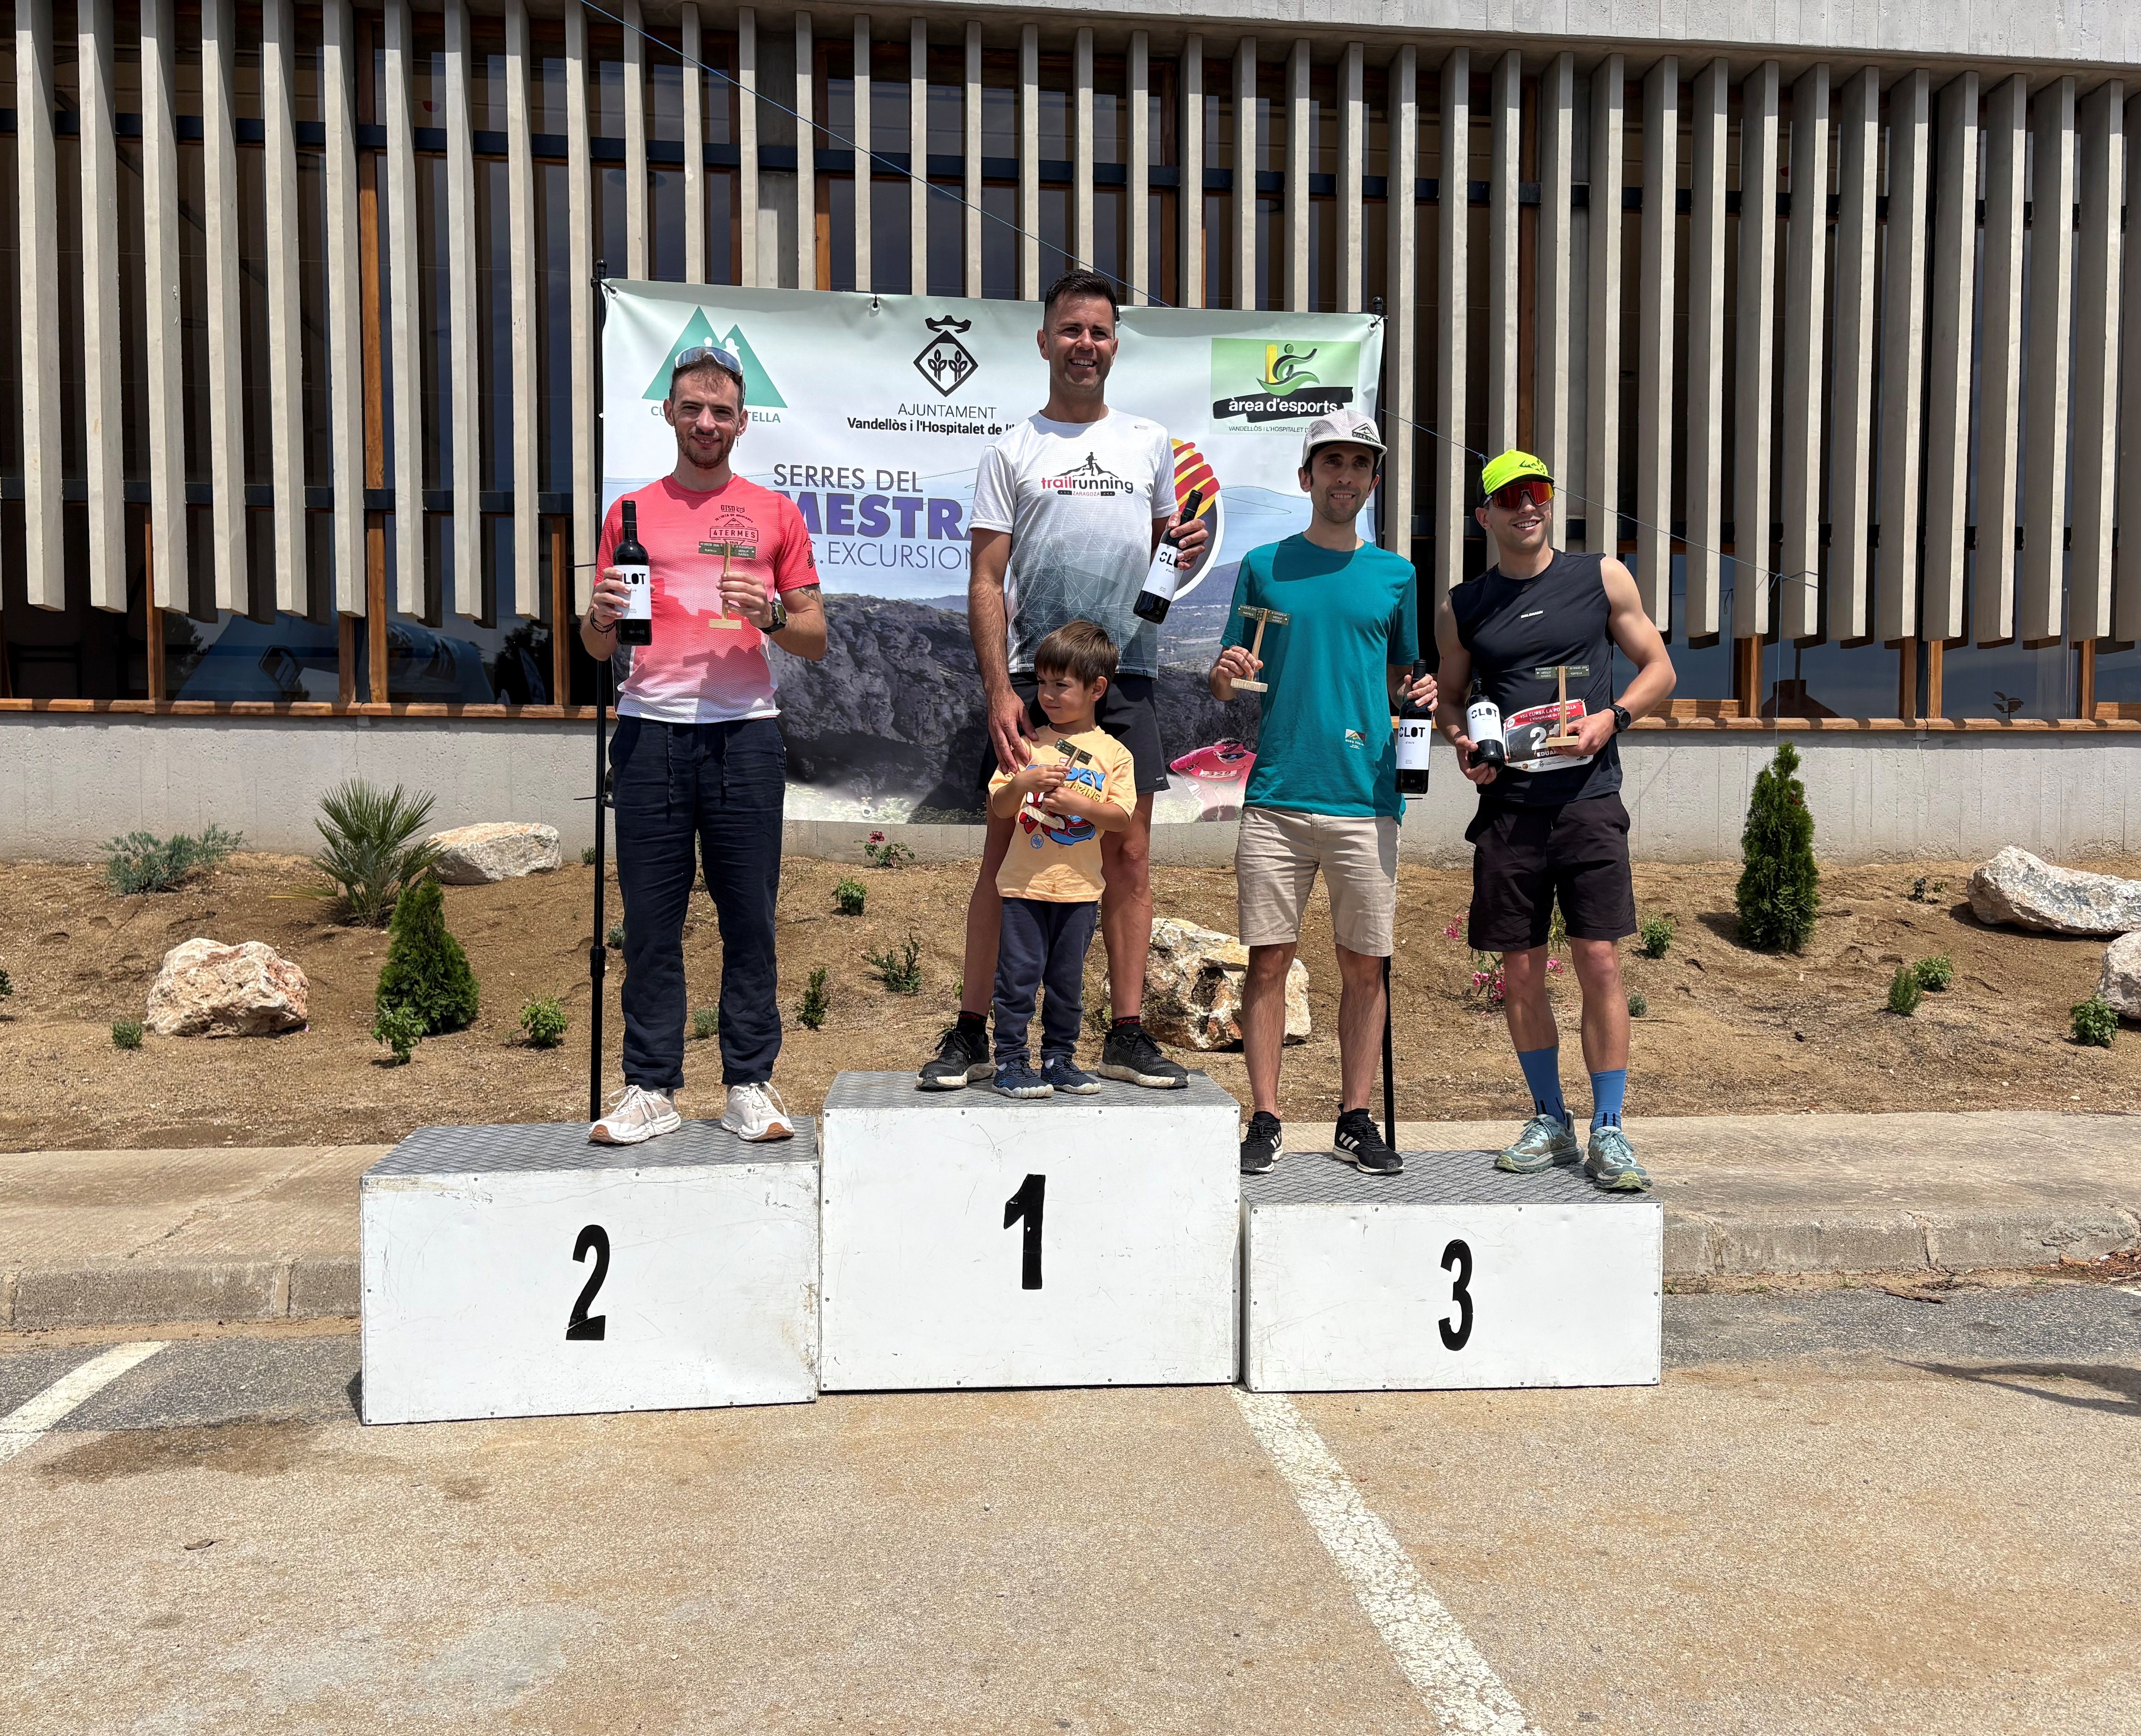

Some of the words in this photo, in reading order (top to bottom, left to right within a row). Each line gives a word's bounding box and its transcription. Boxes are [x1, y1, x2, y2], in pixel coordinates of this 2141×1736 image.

[898, 403, 997, 419] AJUNTAMENT
[1229, 397, 1264, 412] àrea
[1266, 398, 1338, 414] d'esports
[847, 417, 907, 431] Vandellòs
[910, 419, 913, 431] i
[917, 420, 985, 436] l'Hospitalet
[988, 423, 1002, 435] de
[774, 463, 865, 489] SERRES
[877, 470, 923, 493] DEL
[1041, 476, 1134, 494] trailrunning
[773, 490, 972, 541] MESTR
[713, 529, 755, 538] 4TERMES
[623, 573, 646, 585] LOT
[1471, 708, 1497, 719] CLOT
[1399, 726, 1426, 737] CLOT
[1003, 1174, 1046, 1290] 1
[566, 1224, 610, 1341] 2
[1438, 1239, 1473, 1351] 3
